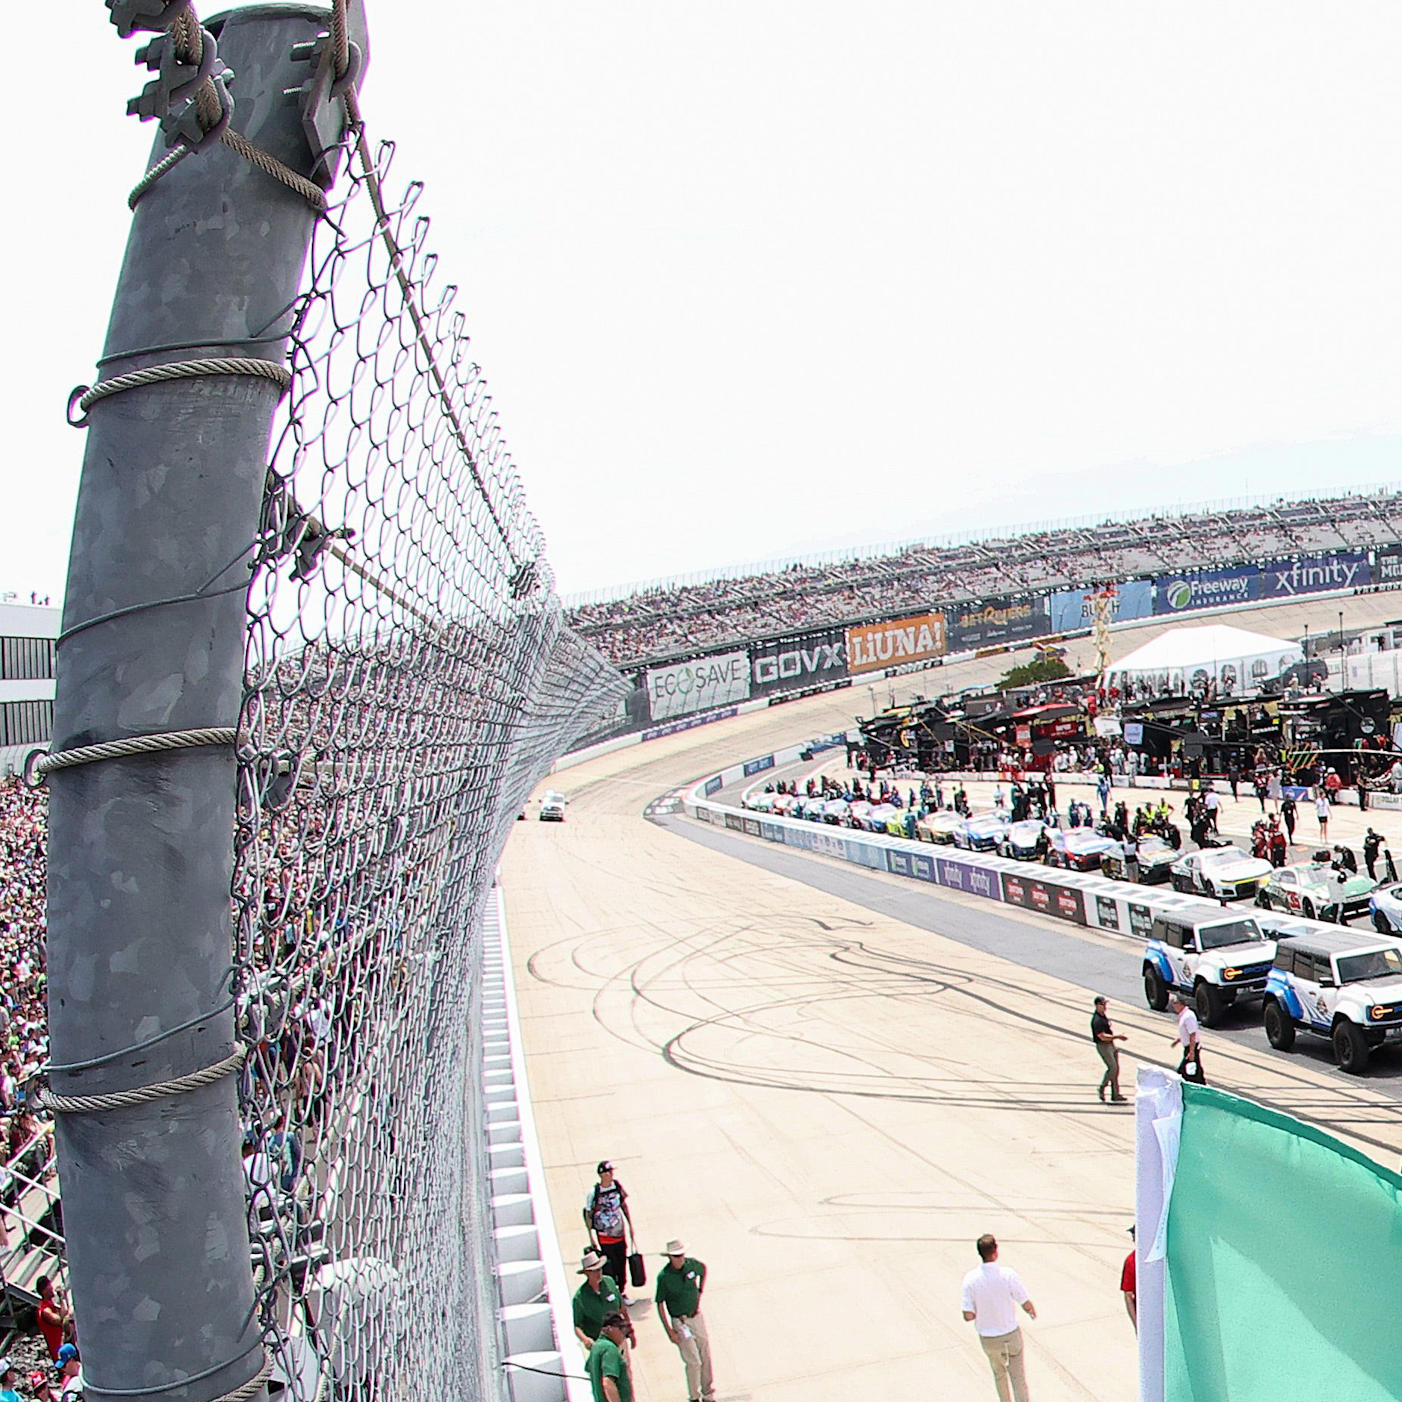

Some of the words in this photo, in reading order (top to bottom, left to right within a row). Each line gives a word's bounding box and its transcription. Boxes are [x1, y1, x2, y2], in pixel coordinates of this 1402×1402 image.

[1275, 559, 1360, 595] xfinity
[1381, 555, 1399, 565] THE
[1190, 578, 1248, 597] Freeway
[1081, 601, 1120, 618] BUH
[853, 621, 943, 667] LiUNA!
[654, 660, 742, 698] ECOSAVE
[755, 642, 844, 684] GOVX
